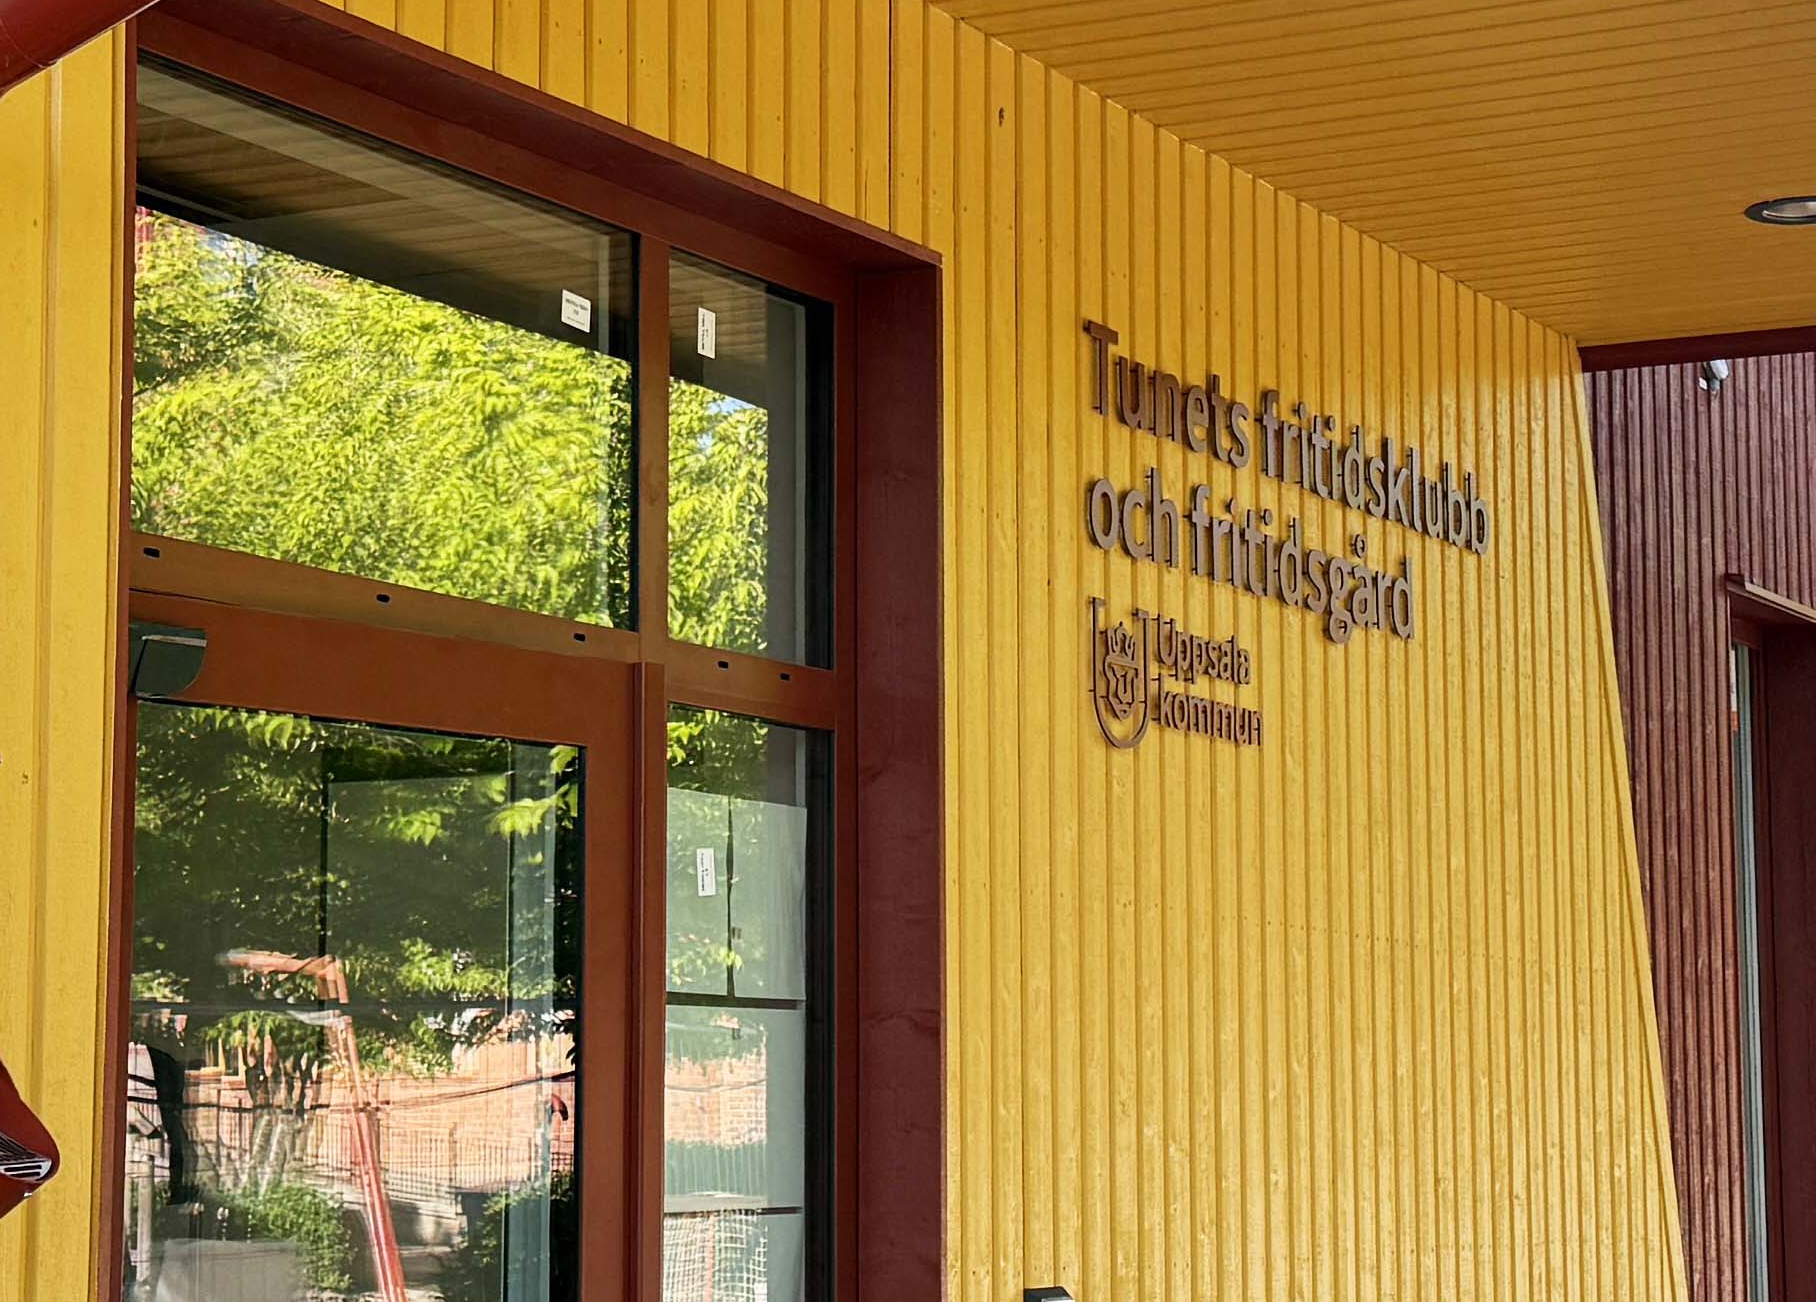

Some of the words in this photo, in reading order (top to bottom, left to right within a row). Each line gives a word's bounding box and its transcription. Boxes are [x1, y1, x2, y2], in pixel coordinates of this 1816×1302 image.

[1084, 319, 1250, 469] Tunets
[1257, 388, 1489, 555] fritidsklubb
[1089, 466, 1179, 569] och
[1186, 484, 1414, 644] fritidsgård
[1154, 614, 1251, 685] Uppsala
[1154, 677, 1264, 747] kommun
